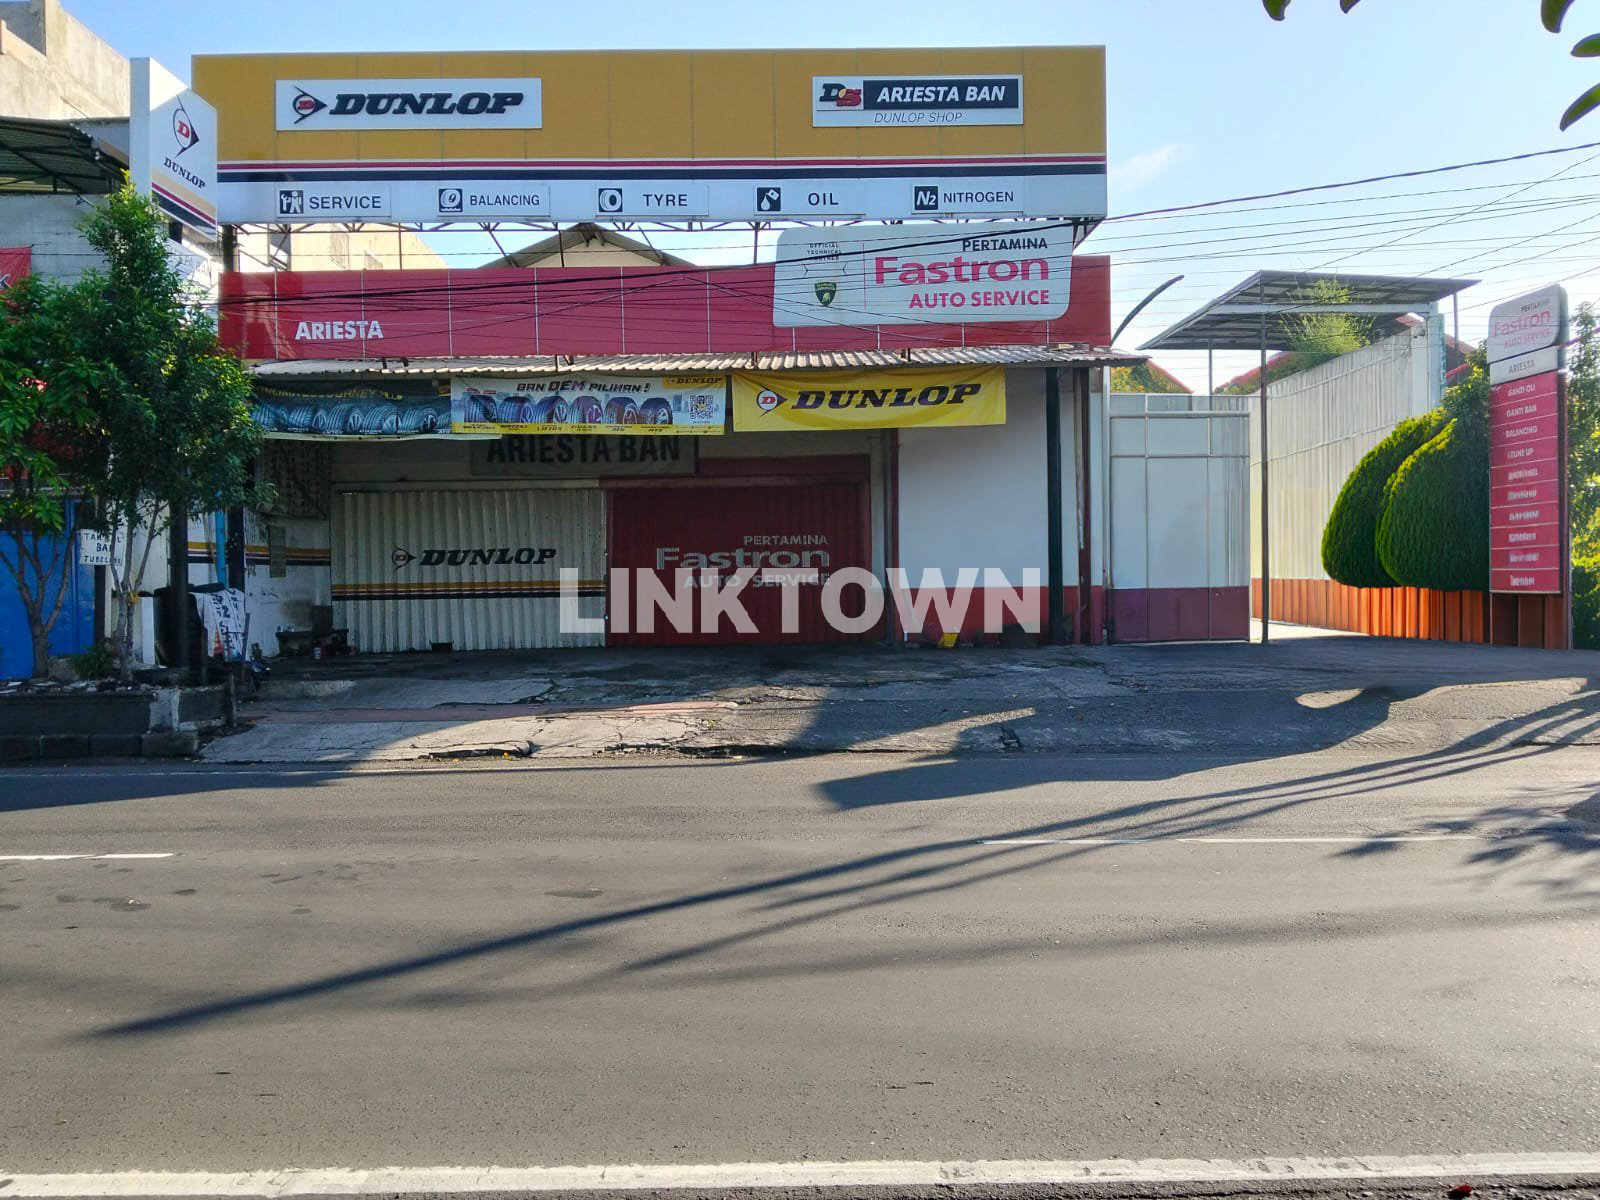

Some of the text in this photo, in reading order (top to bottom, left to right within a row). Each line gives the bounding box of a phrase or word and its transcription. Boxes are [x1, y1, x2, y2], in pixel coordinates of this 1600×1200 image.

[877, 86, 1006, 102] ARIESTA BAN
[329, 93, 524, 115] DUNLOP
[874, 112, 963, 123] DUNLOP SHOP
[163, 157, 206, 190] DUNLOP
[309, 196, 382, 209] SERVICE
[469, 194, 540, 206] BALANCING
[643, 193, 688, 206] TYRE
[808, 193, 839, 205] OIL
[943, 191, 1014, 203] NITROGEN
[962, 237, 1048, 252] PERTAMINA
[875, 255, 1049, 285] Fastron
[909, 290, 1049, 309] AUTO SERVICE
[1492, 309, 1550, 337] Fastron
[1508, 359, 1535, 374] ARIESTA
[516, 383, 545, 393] BAN
[548, 381, 585, 392] OEM
[675, 376, 722, 385] DUNLOP
[791, 383, 981, 411] DUNLOP
[488, 434, 680, 463] ARIESTA BAN
[84, 533, 121, 543] TAL
[743, 535, 829, 545] PERTAMINA
[96, 542, 113, 552] BA
[419, 548, 557, 566] DUNLOP
[656, 547, 830, 571] Fastron
[684, 573, 830, 589] AUTO SERVICE
